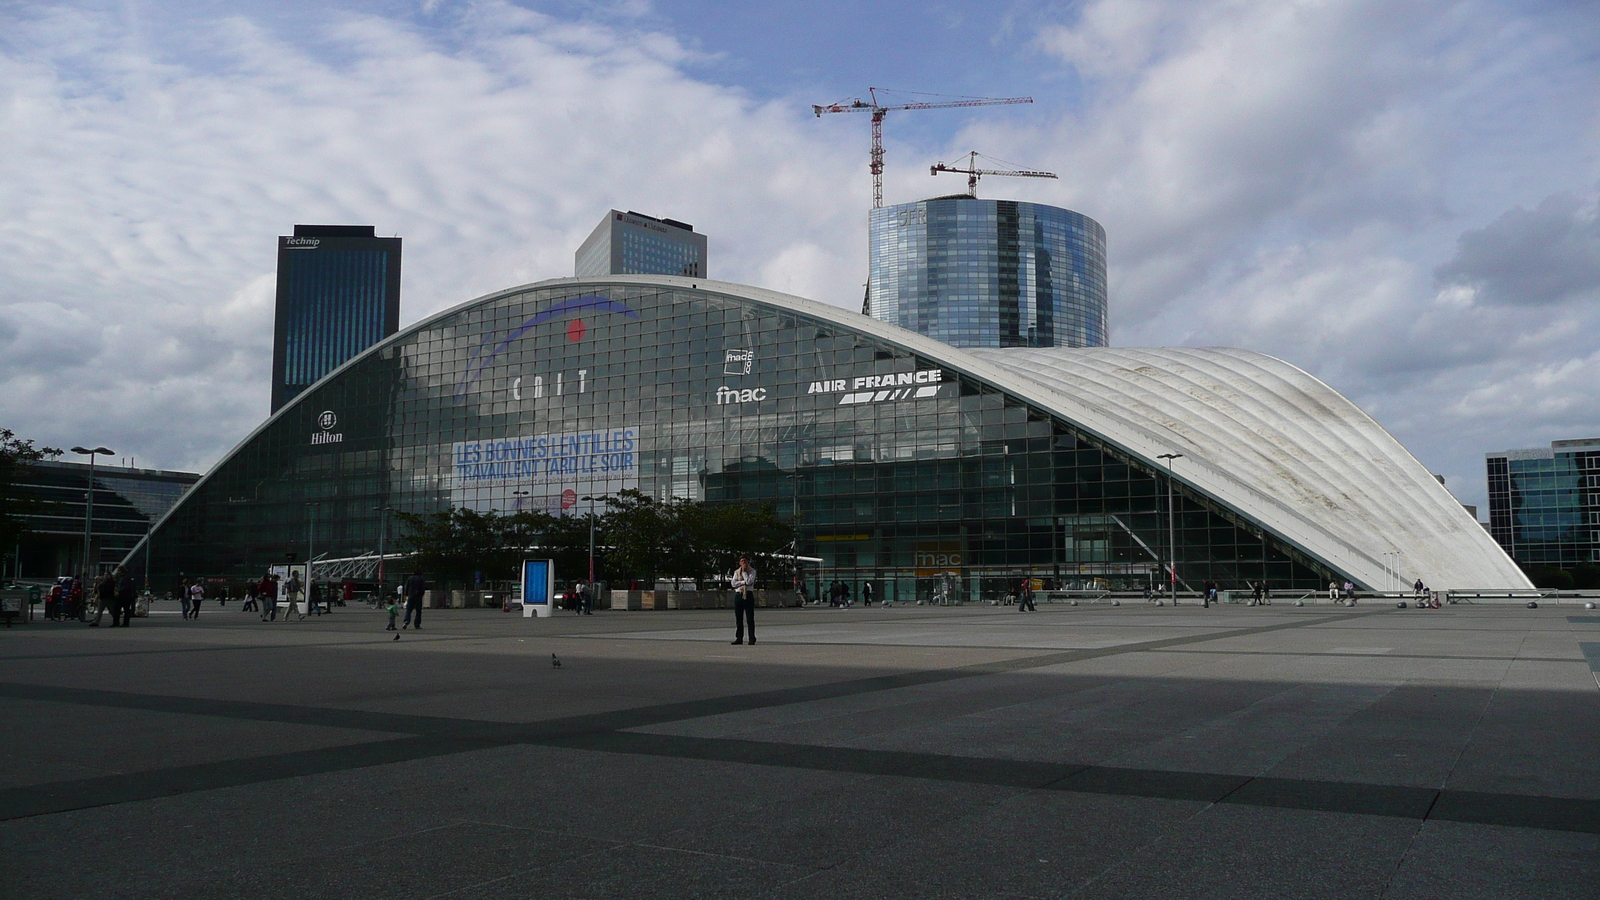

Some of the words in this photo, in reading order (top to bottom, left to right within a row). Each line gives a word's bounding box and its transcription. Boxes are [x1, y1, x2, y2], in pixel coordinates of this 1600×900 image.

[899, 208, 927, 227] SFR
[285, 236, 320, 247] Technip
[808, 379, 846, 394] AIR
[854, 369, 942, 390] FRANCE
[716, 385, 767, 405] fnac
[311, 430, 343, 445] Hilton
[457, 443, 482, 464] LES
[485, 437, 547, 462] BONNES
[551, 430, 634, 457] LENTILLES
[456, 459, 540, 481] TRAVAILLENT
[542, 456, 577, 475] TARD
[582, 454, 597, 473] LE
[601, 452, 634, 472] SOIR
[913, 550, 961, 566] fnac
